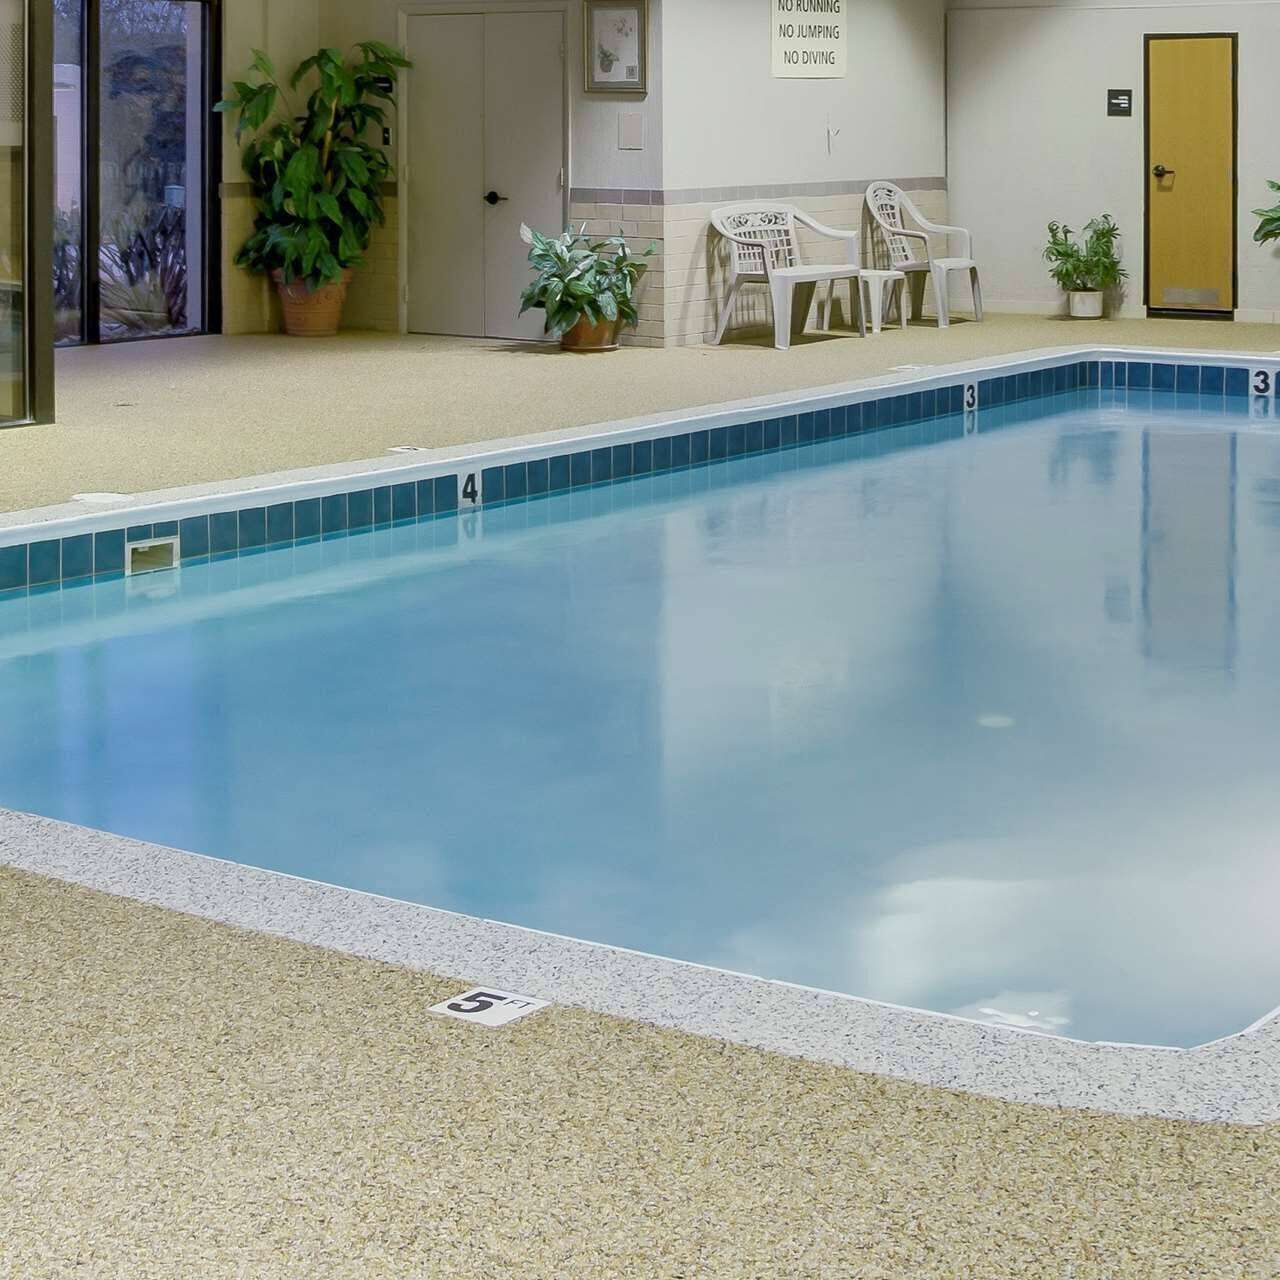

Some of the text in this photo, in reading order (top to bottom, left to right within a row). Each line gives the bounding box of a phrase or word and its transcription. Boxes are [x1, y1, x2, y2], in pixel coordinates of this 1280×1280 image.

[796, 0, 840, 13] RUNNING
[779, 24, 840, 39] NO JUMPING
[784, 51, 836, 64] NO DIVING
[1253, 370, 1270, 394] 3
[965, 384, 976, 409] 3
[462, 473, 478, 504] 4
[447, 991, 508, 1014] 5
